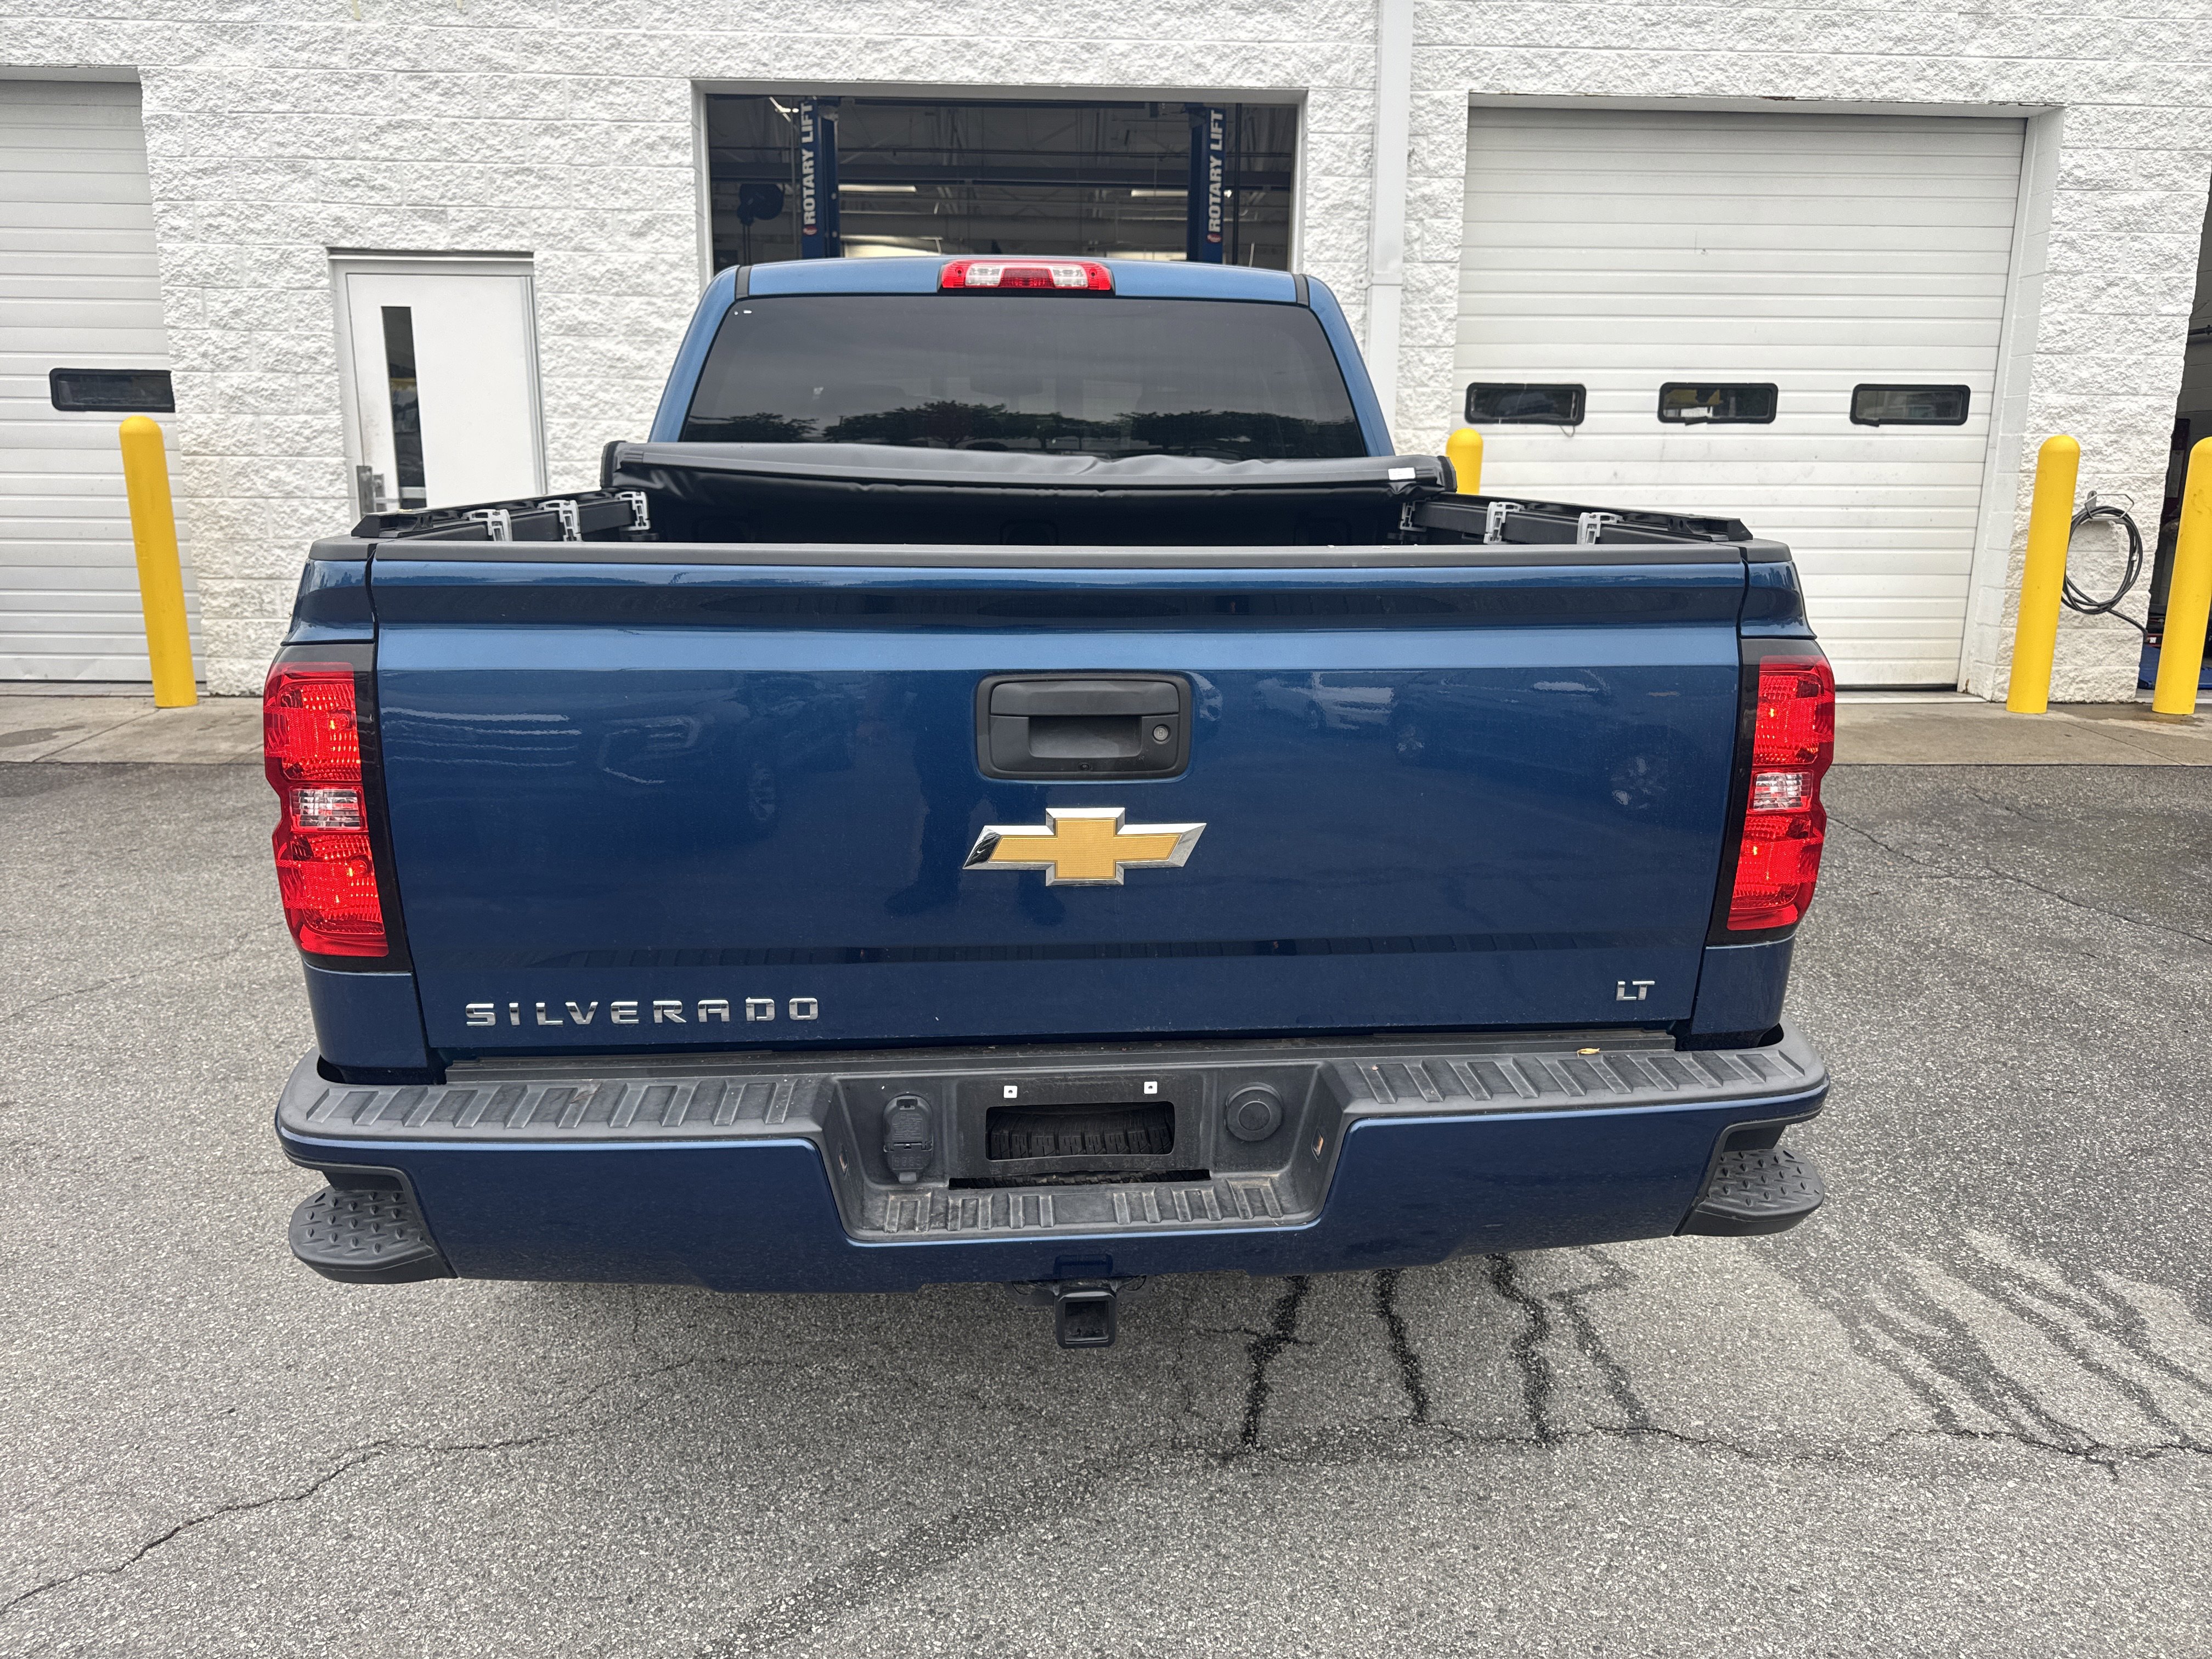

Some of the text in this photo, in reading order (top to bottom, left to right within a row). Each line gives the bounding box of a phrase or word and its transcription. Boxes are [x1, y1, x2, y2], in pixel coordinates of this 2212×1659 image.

[800, 103, 814, 143] LIFT
[1210, 110, 1223, 151] LIFT
[802, 148, 816, 225] ROTARY
[1209, 155, 1222, 233] ROTARY
[1616, 980, 1656, 1001] LT
[465, 997, 819, 1027] SILVERADO
